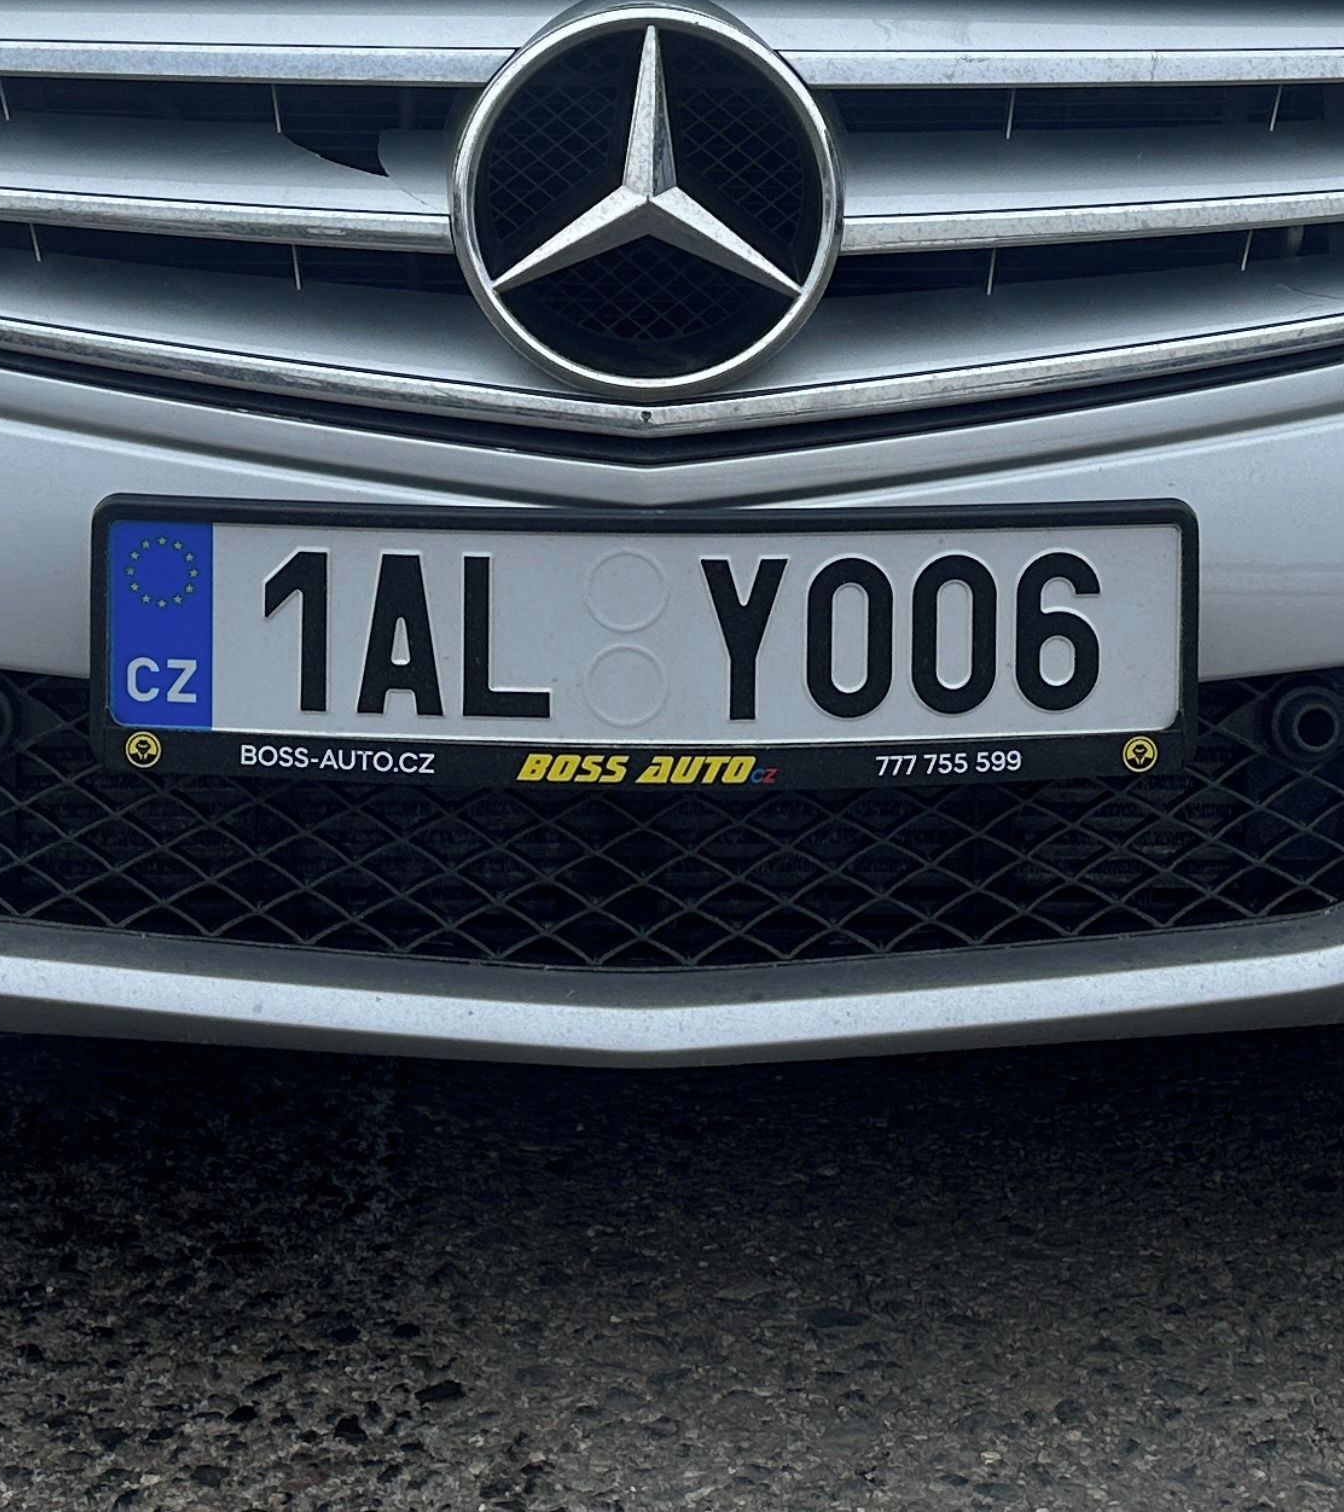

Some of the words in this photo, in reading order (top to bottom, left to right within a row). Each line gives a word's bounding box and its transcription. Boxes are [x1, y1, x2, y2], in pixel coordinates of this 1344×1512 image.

[262, 550, 551, 719] 1AL
[700, 551, 1101, 721] Y006
[126, 656, 198, 704] CZ
[240, 744, 435, 774] BOSS-AUTO.CZ
[516, 753, 630, 784] BOSS
[634, 755, 757, 785] AUTO
[875, 754, 917, 776] 777
[923, 752, 968, 775] 755
[975, 749, 1022, 772] 599
